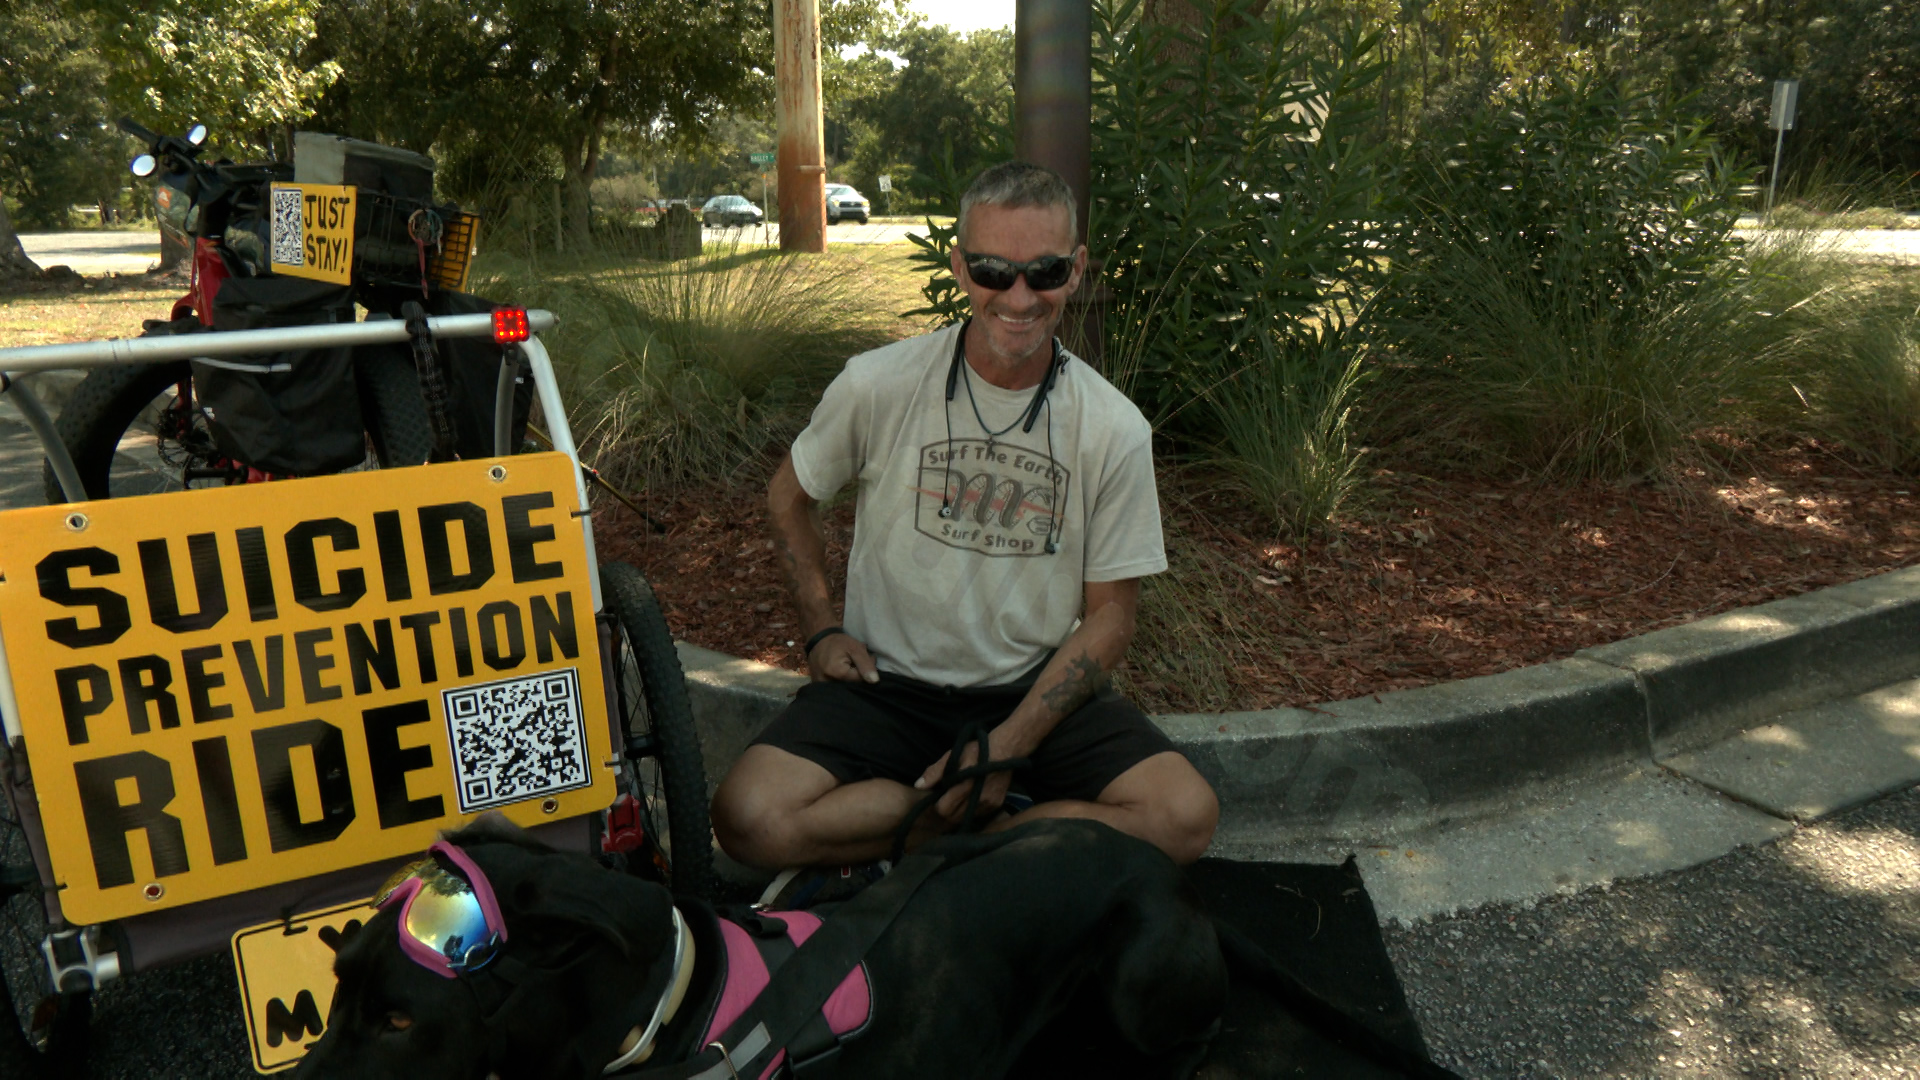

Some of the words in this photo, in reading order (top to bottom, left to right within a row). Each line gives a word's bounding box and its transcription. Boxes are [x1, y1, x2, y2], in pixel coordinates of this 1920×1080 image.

[304, 195, 351, 230] JUST
[306, 233, 349, 275] STAY!
[928, 445, 969, 465] Surf
[975, 443, 1008, 464] The
[1013, 454, 1063, 486] Earth
[941, 523, 982, 542] Surf
[984, 534, 1035, 552] Shop
[35, 491, 564, 649] SUICIDE
[54, 591, 580, 746] PREVENTION
[73, 699, 445, 890] RIDE
